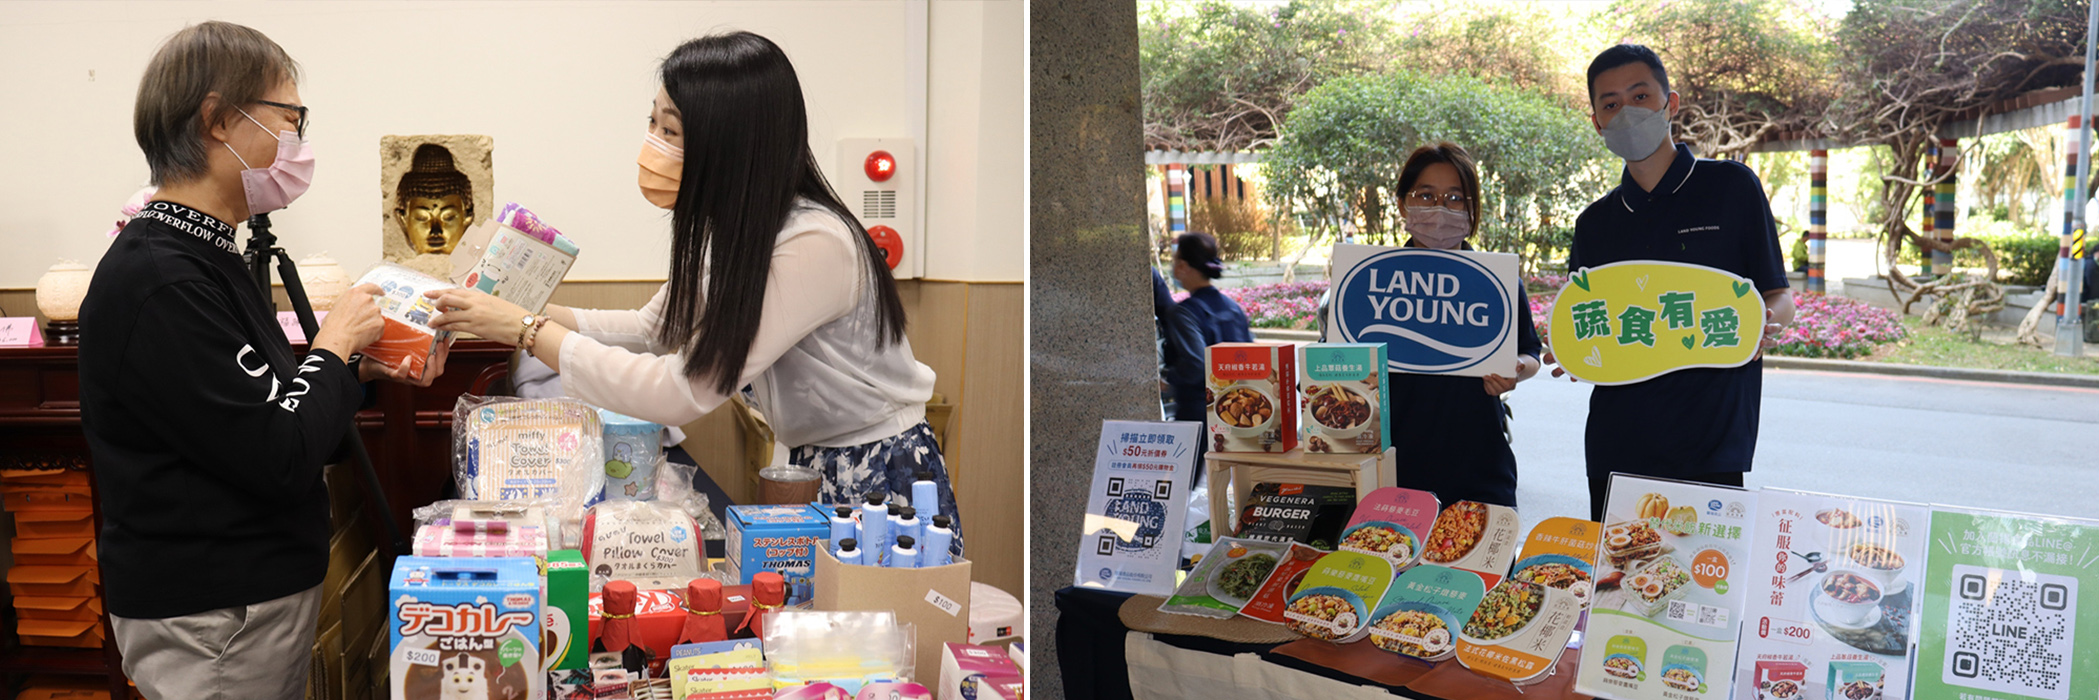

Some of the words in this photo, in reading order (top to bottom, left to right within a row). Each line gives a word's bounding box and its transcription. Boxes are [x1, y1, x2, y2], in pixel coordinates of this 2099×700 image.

[1368, 268, 1460, 297] LAND
[1367, 294, 1489, 327] YOUNG
[1570, 291, 1741, 348] 蔬食有愛
[518, 431, 546, 445] miffy
[1120, 432, 1176, 445] 掃描立即領取
[511, 442, 550, 456] Towel
[510, 456, 551, 469] Cover
[1260, 495, 1316, 506] VEGENERA
[1252, 506, 1312, 520] BURGER
[628, 531, 665, 545] Towel
[603, 546, 643, 560] Pillow
[650, 546, 689, 558] Cover
[1482, 527, 1506, 570] 花椰米
[761, 560, 812, 569] THOMAS
[1770, 518, 1794, 607] 征服你的味蕾
[1694, 562, 1726, 579] $100
[933, 595, 953, 612] $100
[401, 605, 534, 634] デコカレー
[1529, 611, 1566, 652] 花椰米
[1783, 625, 1811, 640] $200
[1992, 623, 2028, 639] LINE
[439, 637, 494, 650] ごはん型
[406, 650, 437, 663] $200
[675, 647, 703, 657] PEANUTS
